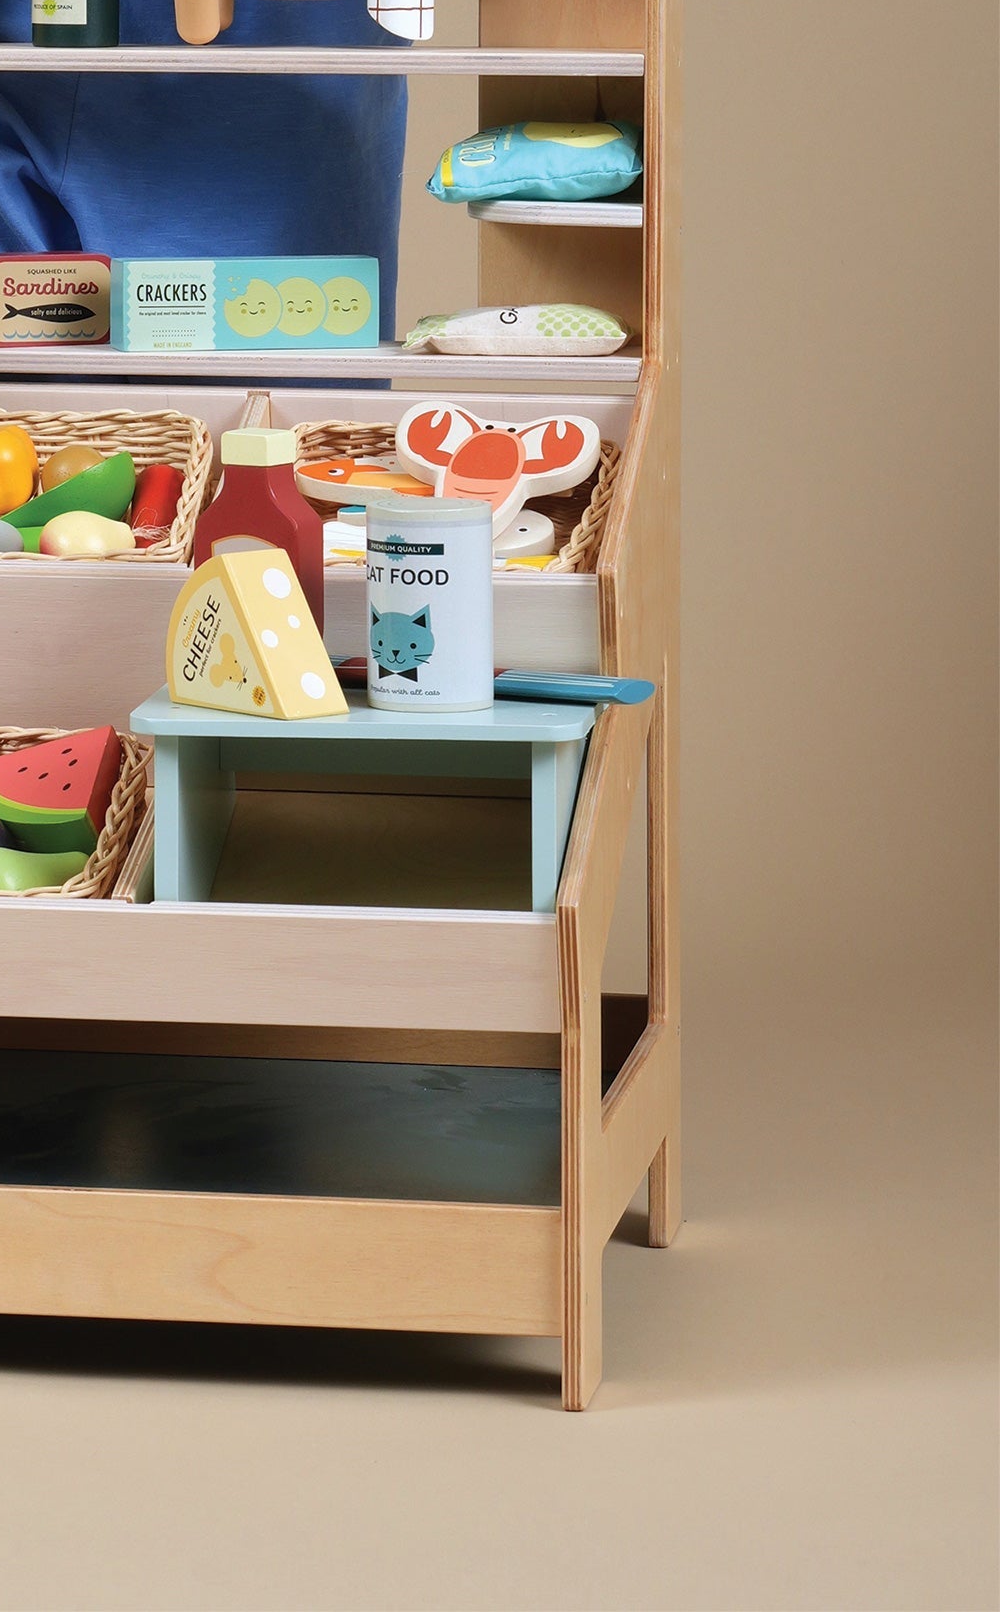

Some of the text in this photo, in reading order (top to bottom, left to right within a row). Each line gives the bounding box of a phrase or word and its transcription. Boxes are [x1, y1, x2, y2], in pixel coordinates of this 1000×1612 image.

[3, 277, 99, 296] Sardines
[137, 284, 207, 302] CRACKERS
[31, 308, 44, 316] salty
[370, 543, 396, 552] PREMIUM
[390, 568, 449, 586] FOOD
[183, 594, 221, 682] CHEESE
[199, 654, 209, 678] perfect
[210, 618, 222, 644] crackers
